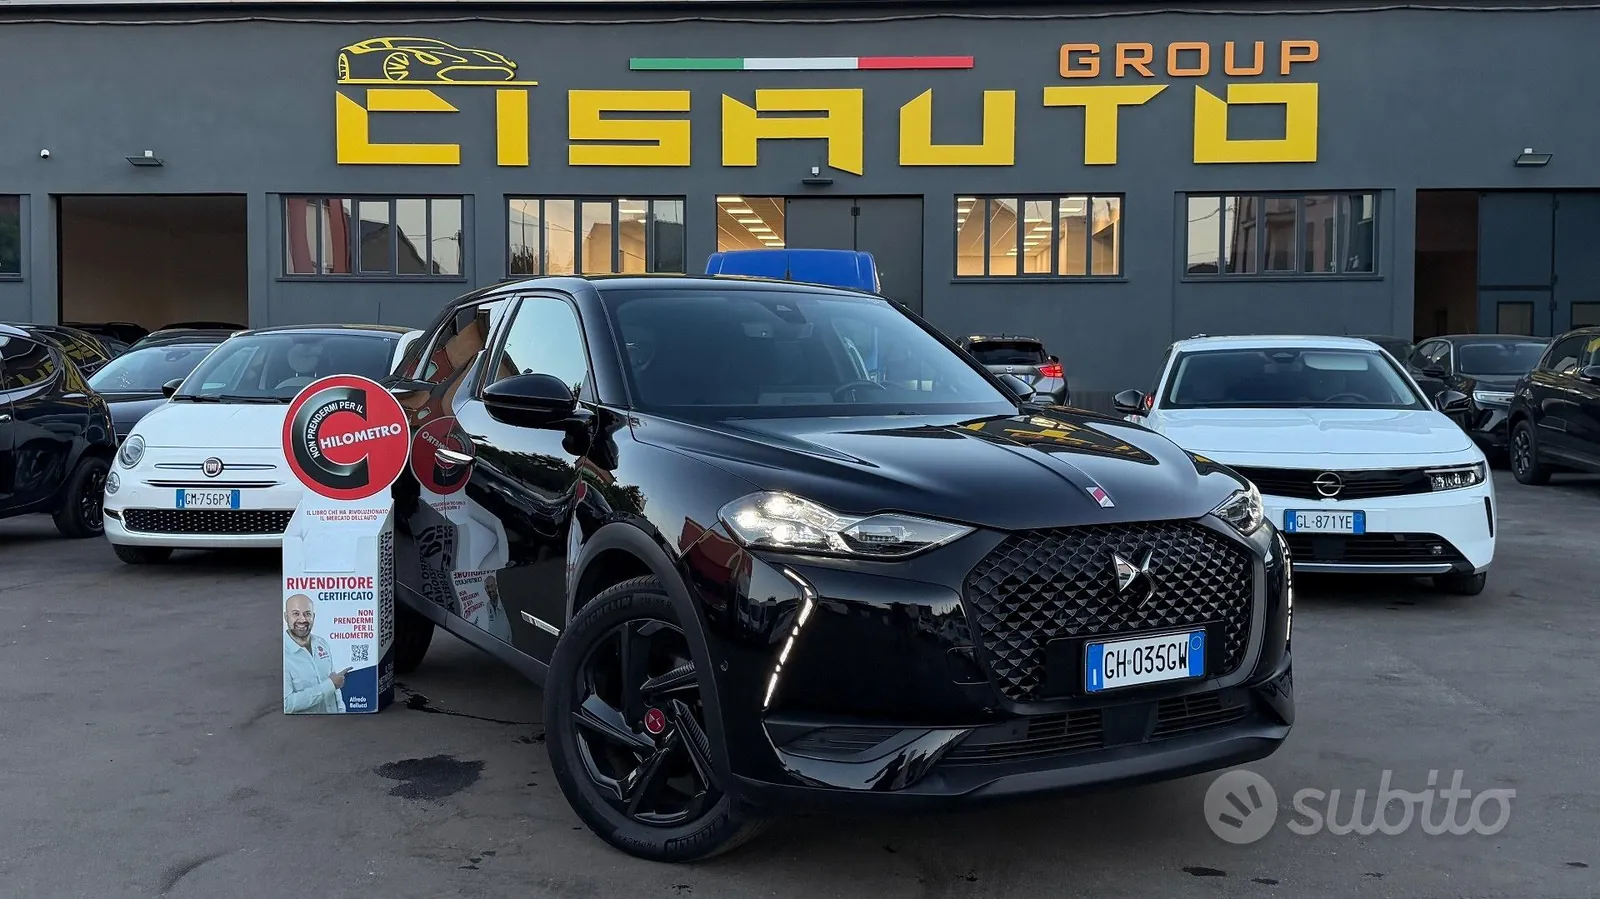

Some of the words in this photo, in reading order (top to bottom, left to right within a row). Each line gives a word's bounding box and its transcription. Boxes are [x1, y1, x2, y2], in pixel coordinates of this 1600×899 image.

[1059, 40, 1319, 78] GROUP
[336, 83, 1319, 175] CISAUTO
[339, 401, 356, 410] PER
[356, 404, 363, 414] IL
[307, 402, 338, 439] PRENDERMI
[320, 423, 402, 449] HILOMETRO
[307, 440, 320, 459] NON
[286, 576, 374, 590] RIVENDITORE
[318, 591, 374, 601] CERTIFICATO
[353, 624, 366, 632] PER
[367, 624, 374, 632] IL
[329, 632, 374, 640] CHILOMETRO
